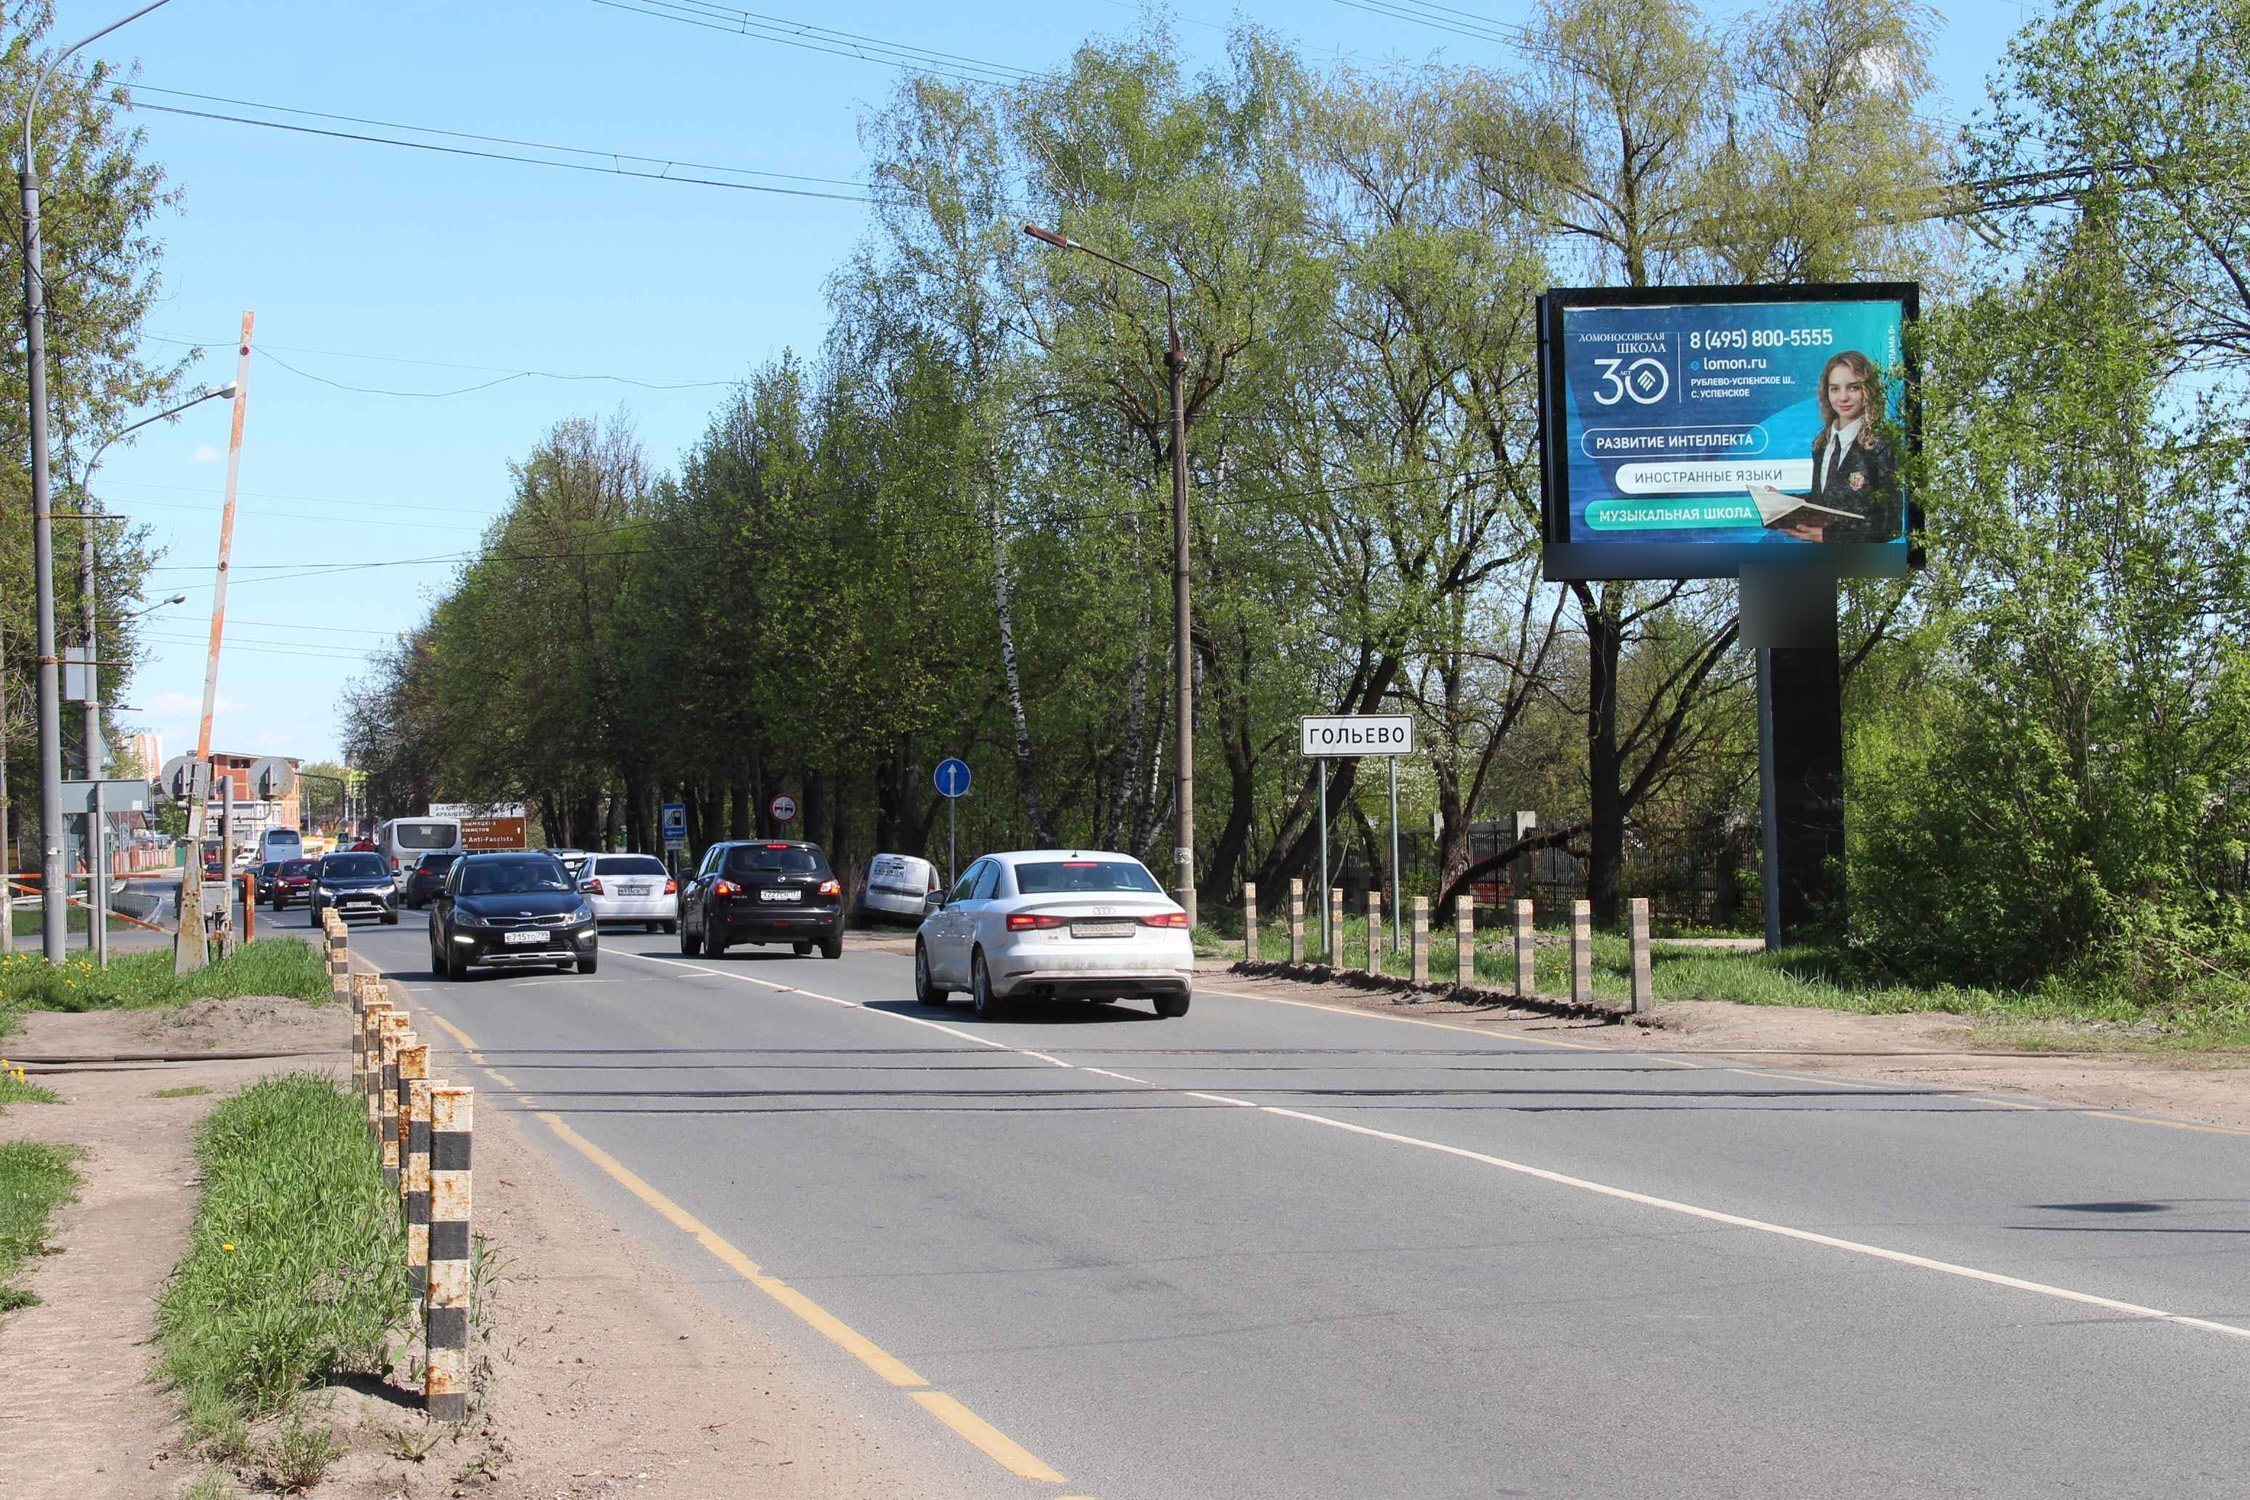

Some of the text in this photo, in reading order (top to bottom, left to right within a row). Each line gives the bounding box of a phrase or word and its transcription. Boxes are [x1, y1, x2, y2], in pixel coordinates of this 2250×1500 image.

[1578, 332, 1665, 342] ЛОМОНОСОВСКАЯ
[1690, 328, 1833, 351] 8 (495) 800-5555
[1616, 342, 1667, 354] ШКОЛА
[1703, 357, 1767, 370] lomon.ru
[1593, 358, 1669, 406] 30
[1690, 376, 1781, 387] РУБЛЕВО-УСПЕНСКОЕ
[1691, 388, 1750, 399] С. УСПЕНСКОЕ
[1596, 433, 1754, 450] РАЗВИТИЕ ИНТЕЛЛЕКТА
[1634, 469, 1783, 484] ИНОСТРАННЫЕ ЯЗЫКИ
[1599, 507, 1753, 523] МУЗЫКАЛЬНАЯ ШКОЛА
[1309, 726, 1405, 745] ГОЛЬЕВО
